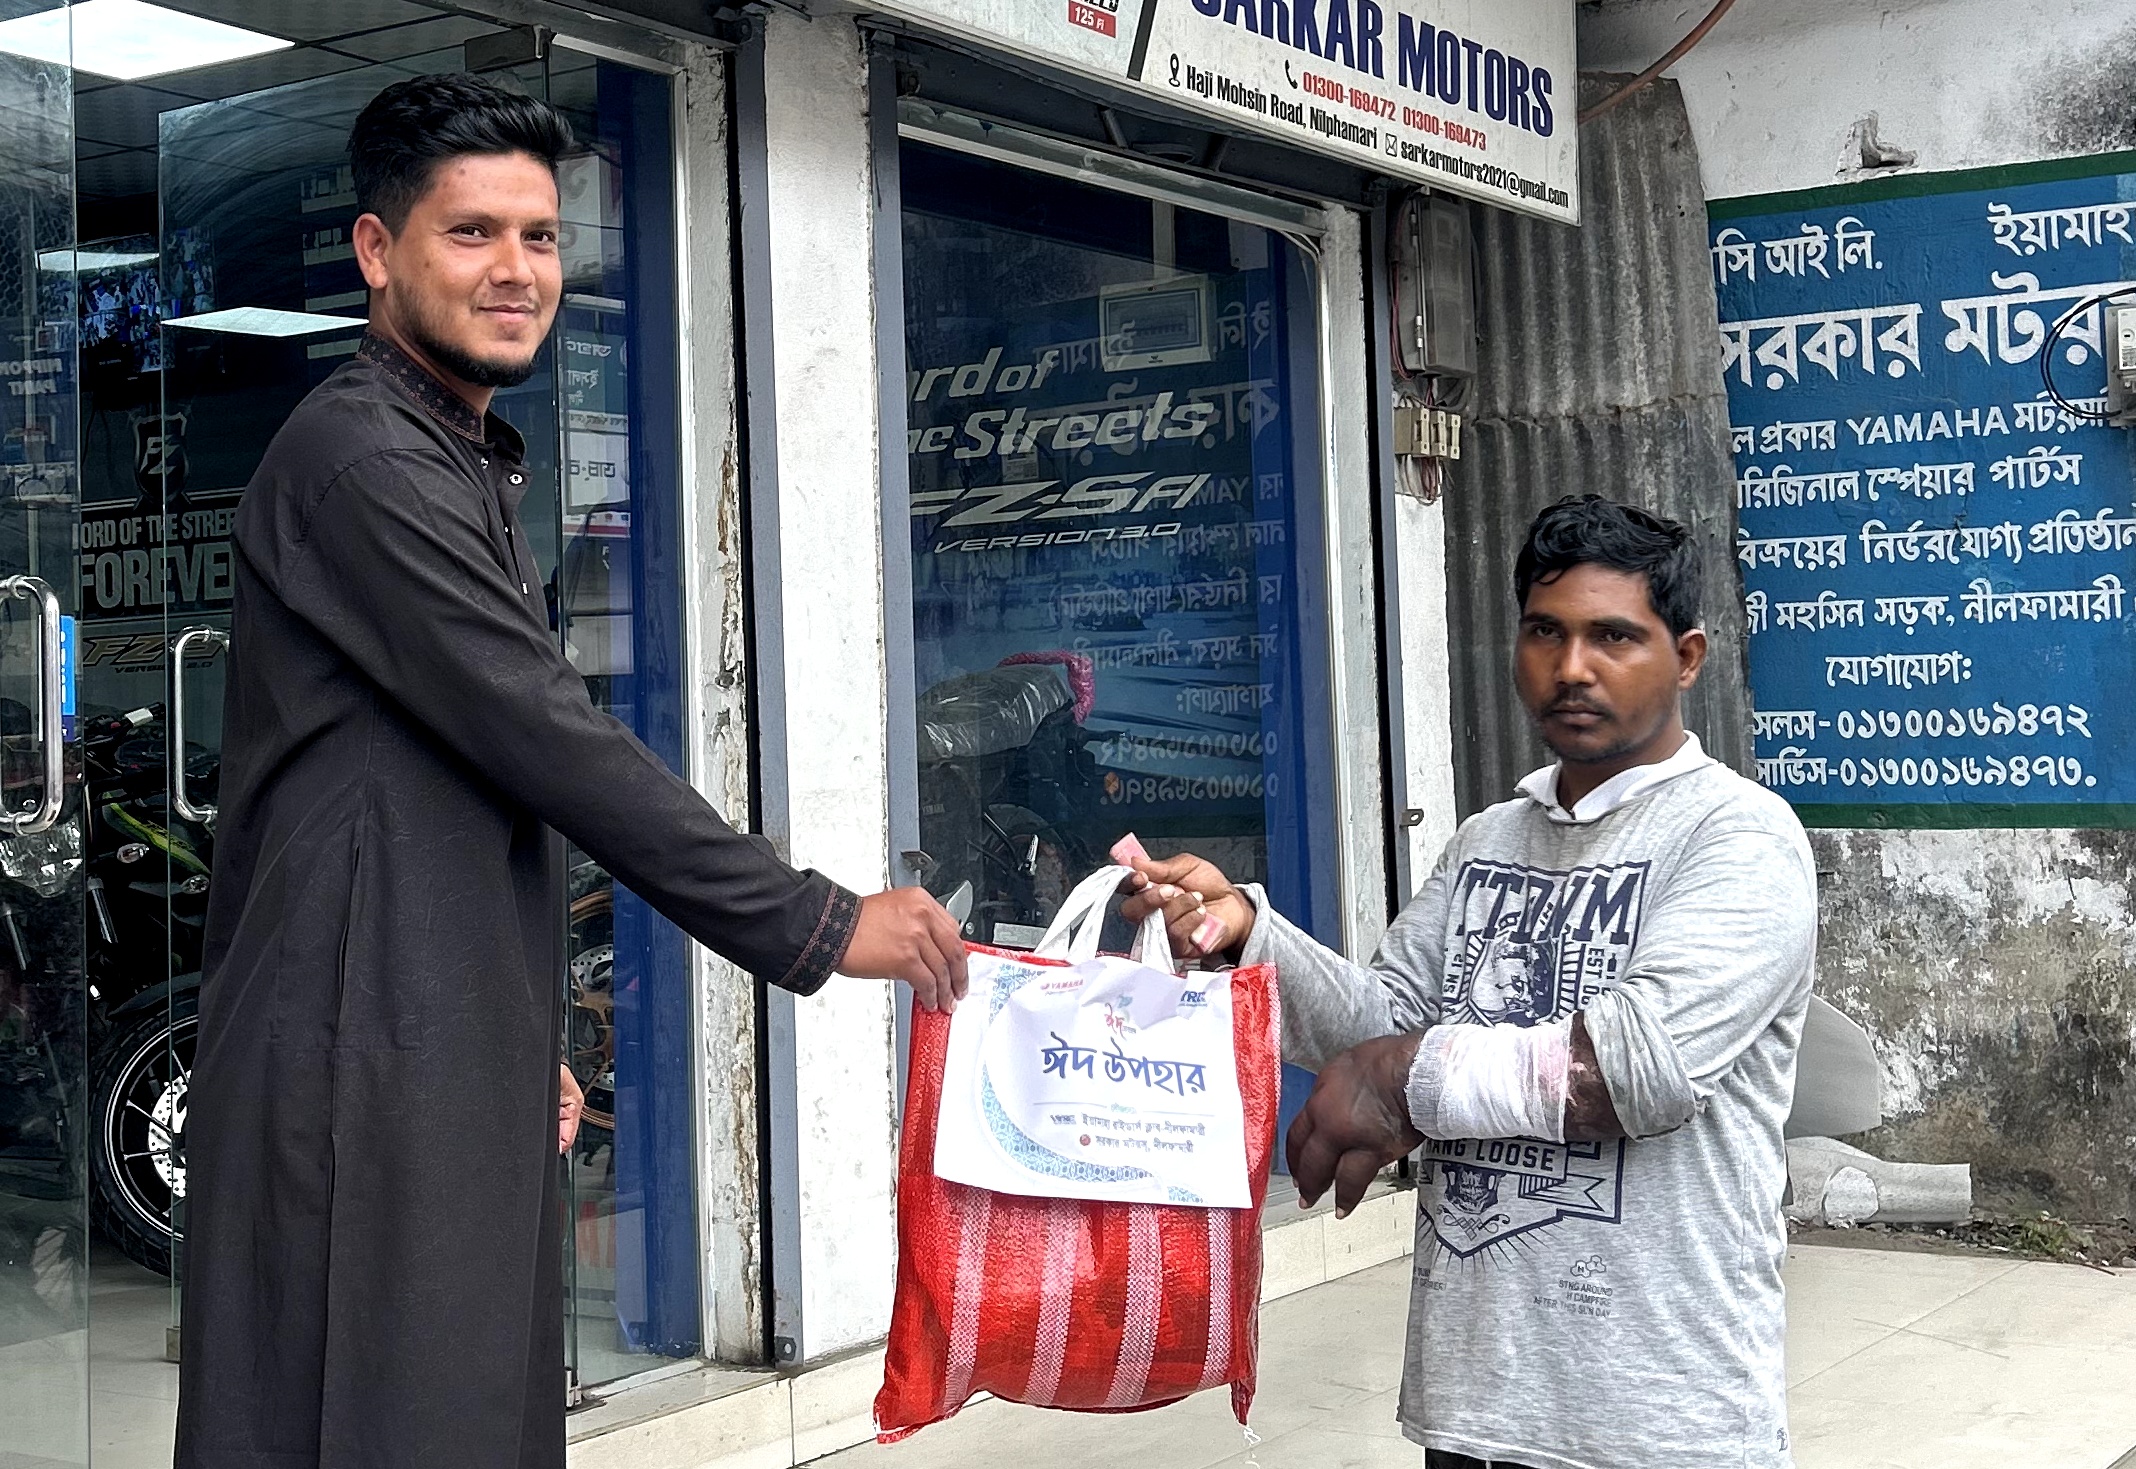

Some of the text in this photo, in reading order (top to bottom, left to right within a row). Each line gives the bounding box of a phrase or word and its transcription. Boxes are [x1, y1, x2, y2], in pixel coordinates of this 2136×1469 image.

[1074, 6, 1094, 26] 125
[1191, 0, 1554, 138] RKAR MOTORS
[1186, 64, 1569, 208] Haji Mohsin Road, Nilphamari sarkarmotors2021@gmail.com
[1303, 72, 1487, 151] 01300-169472 01300-169473
[1761, 223, 1831, 279] আই
[1986, 202, 2136, 256] ইয়ামাহ
[1719, 270, 2136, 392] সরকার মটর
[995, 351, 1059, 392] of
[954, 391, 1214, 459] Streets
[1760, 420, 1836, 453] প্রকার
[1846, 405, 2010, 445] YAMAHA
[1868, 461, 1975, 501] স্পেয়ার
[1989, 445, 2083, 490] পার্টস
[120, 517, 142, 545] OF
[146, 513, 178, 542] THE
[935, 522, 1182, 554] VERSION 3.0
[1859, 519, 2022, 565] নির্ভরযোগ্য
[73, 541, 236, 611] FOREVE
[1775, 590, 1865, 632] মহসিন
[1874, 595, 1956, 636] সড়ক,
[1960, 574, 2126, 624] নীলফামারী
[1585, 948, 1605, 979] EST
[1041, 1031, 1206, 1096] ঈদ উপহার
[1475, 1139, 1556, 1172] LOOSE
